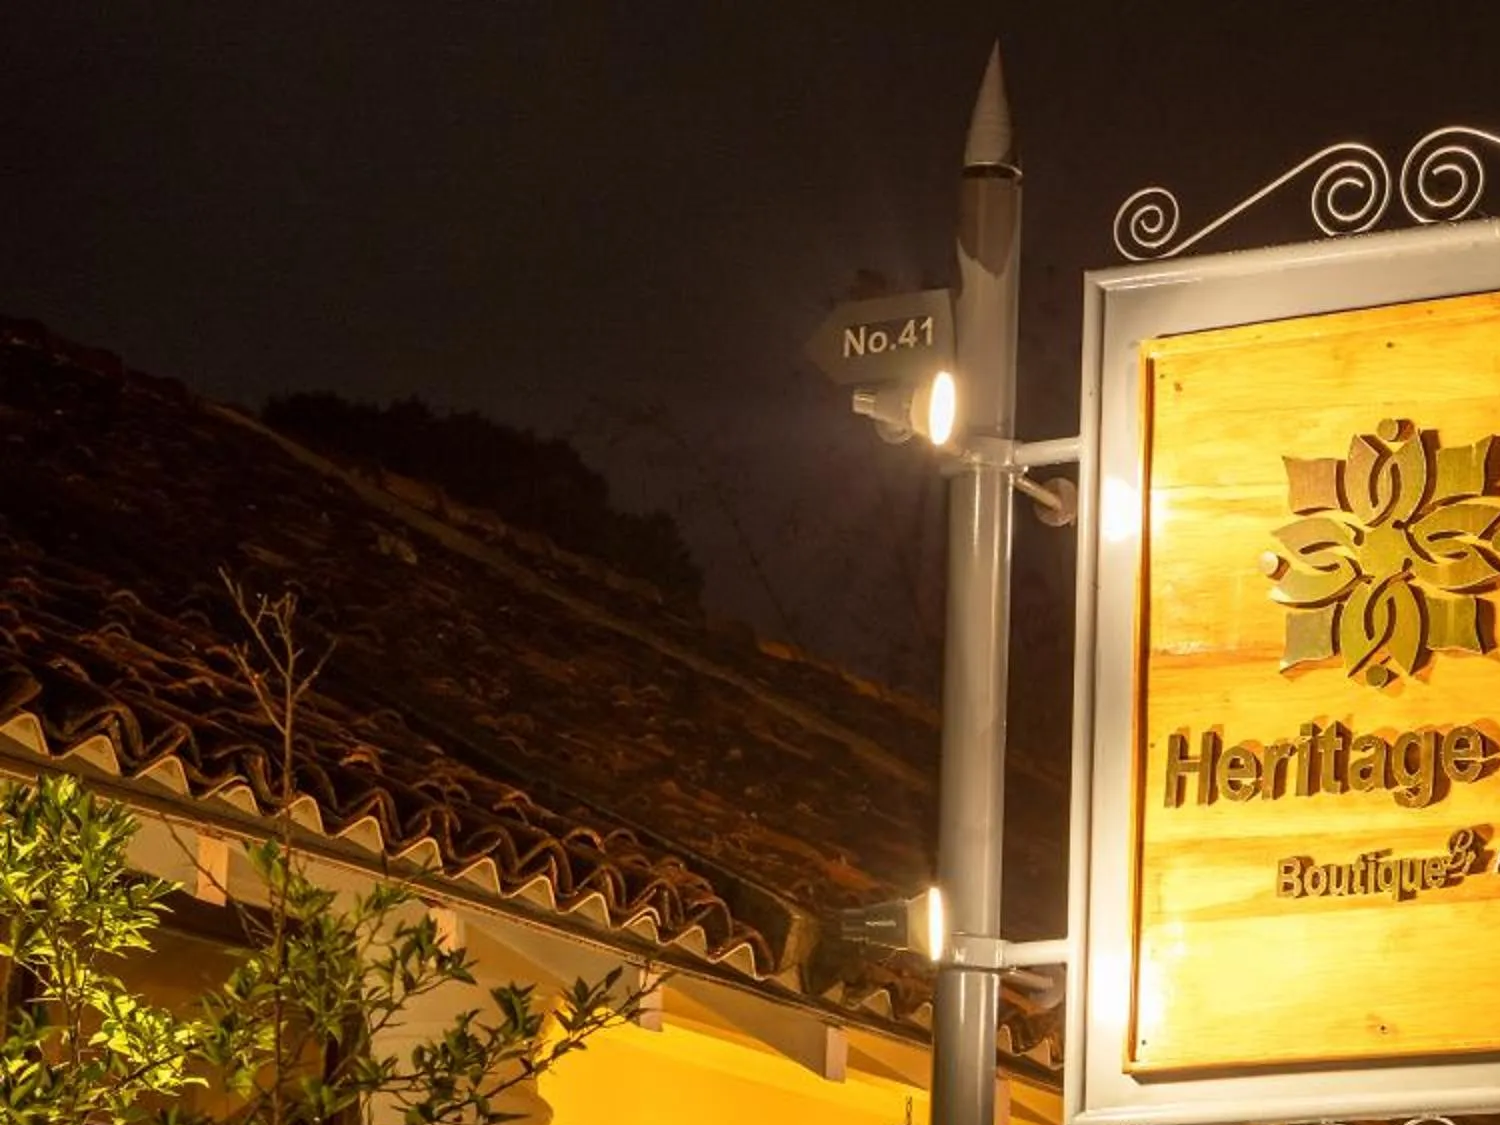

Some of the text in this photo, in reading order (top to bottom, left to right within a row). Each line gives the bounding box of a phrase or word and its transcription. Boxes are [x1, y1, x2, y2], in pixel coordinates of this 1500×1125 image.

[843, 316, 934, 358] No.41
[1164, 720, 1488, 809] Heritage
[1276, 851, 1449, 900] Boutique
